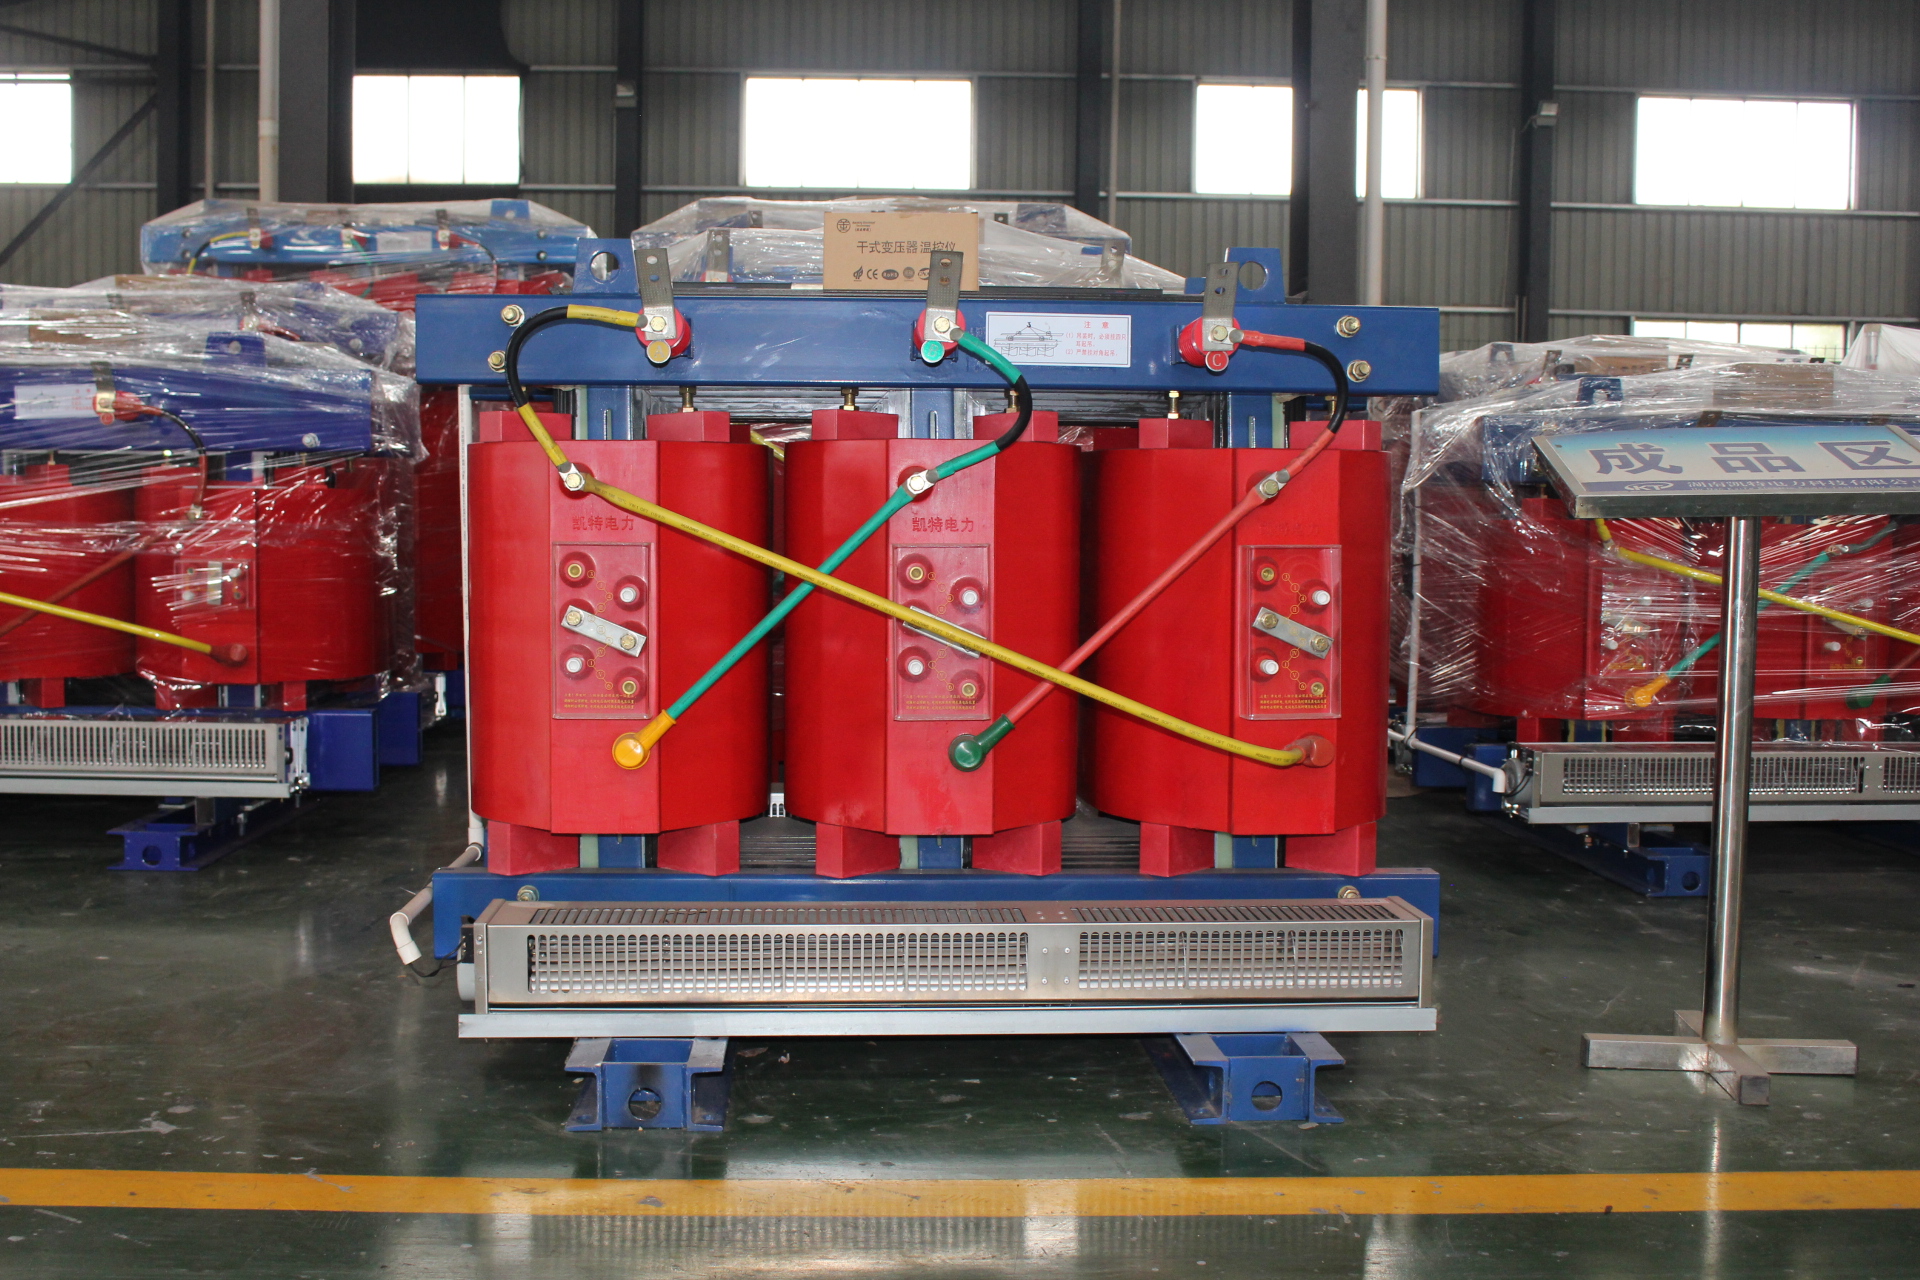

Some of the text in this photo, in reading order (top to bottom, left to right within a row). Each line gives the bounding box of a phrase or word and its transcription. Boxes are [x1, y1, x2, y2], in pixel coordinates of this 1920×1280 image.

[856, 240, 956, 254] 干式变压器温控仪
[866, 269, 878, 280] CE
[654, 345, 664, 358] A
[928, 343, 939, 357] B
[1212, 354, 1222, 366] C
[1588, 440, 1920, 475] 成品区
[572, 516, 634, 531] 凯特电力
[912, 517, 974, 533] 凯特电力
